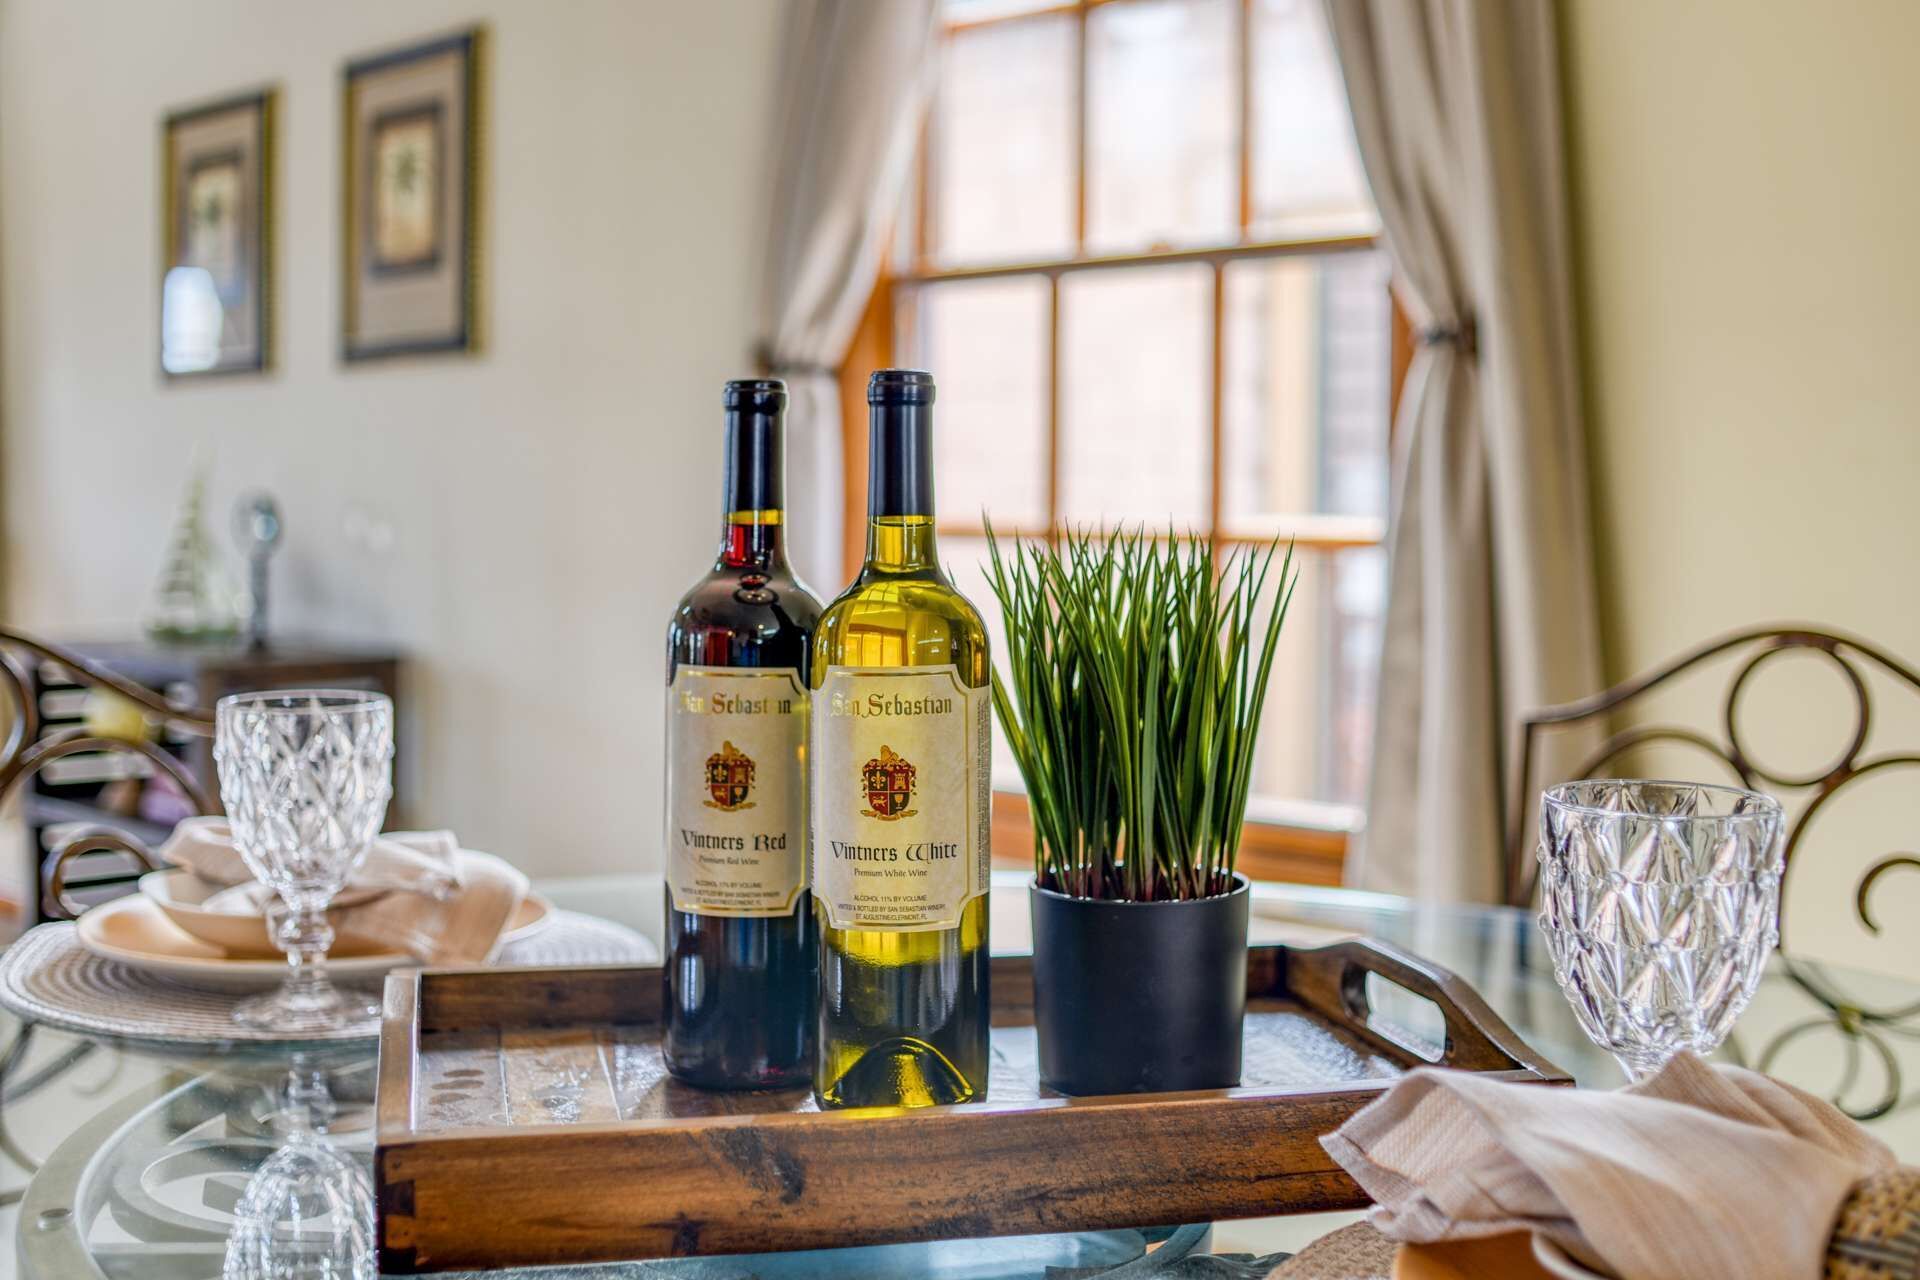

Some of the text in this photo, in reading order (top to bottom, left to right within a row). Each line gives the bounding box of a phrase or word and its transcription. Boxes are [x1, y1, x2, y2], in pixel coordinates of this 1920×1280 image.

[862, 693, 952, 718] Sebastian
[681, 829, 787, 852] Vintners Red
[831, 841, 959, 864] Vintners White
[854, 868, 928, 878] Premium White Wine
[854, 894, 880, 902] ALCOHOL
[903, 894, 928, 902] VOLUME
